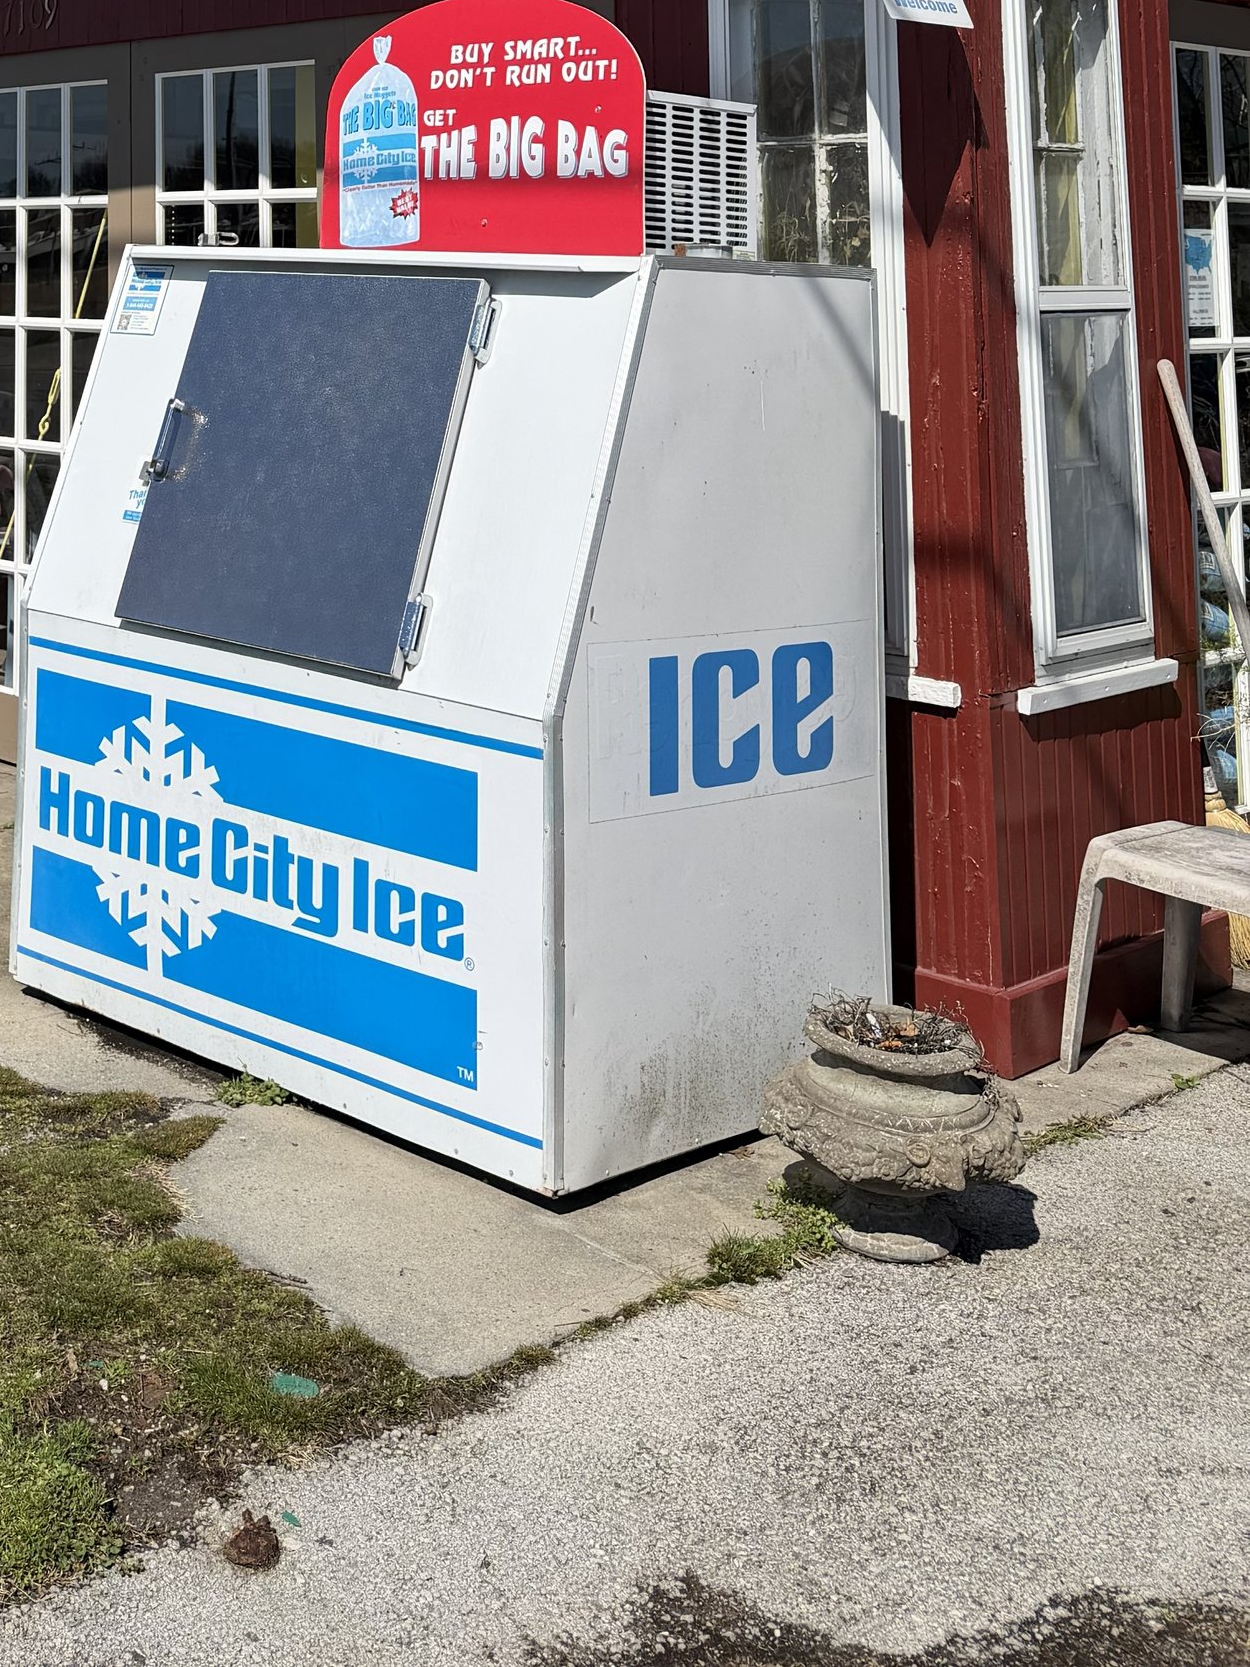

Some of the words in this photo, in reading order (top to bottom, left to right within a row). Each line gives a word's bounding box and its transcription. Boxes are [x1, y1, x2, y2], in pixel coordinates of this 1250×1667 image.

[450, 42, 495, 65] BUY
[503, 35, 598, 61] SMART...
[430, 65, 496, 90] DON'T
[505, 61, 551, 86] RUN
[562, 58, 619, 83] OUT!
[342, 105, 360, 135] THE
[363, 99, 394, 131] BIG
[396, 99, 417, 127] BAG
[423, 109, 456, 128] GET
[343, 156, 375, 172] Home
[376, 152, 400, 166] City
[401, 150, 417, 164] Ice
[421, 125, 478, 180] THE
[488, 114, 547, 180] BIG
[556, 120, 629, 179] BAG
[39, 765, 201, 879] Home
[211, 818, 340, 939] City
[352, 857, 465, 962] Ice
